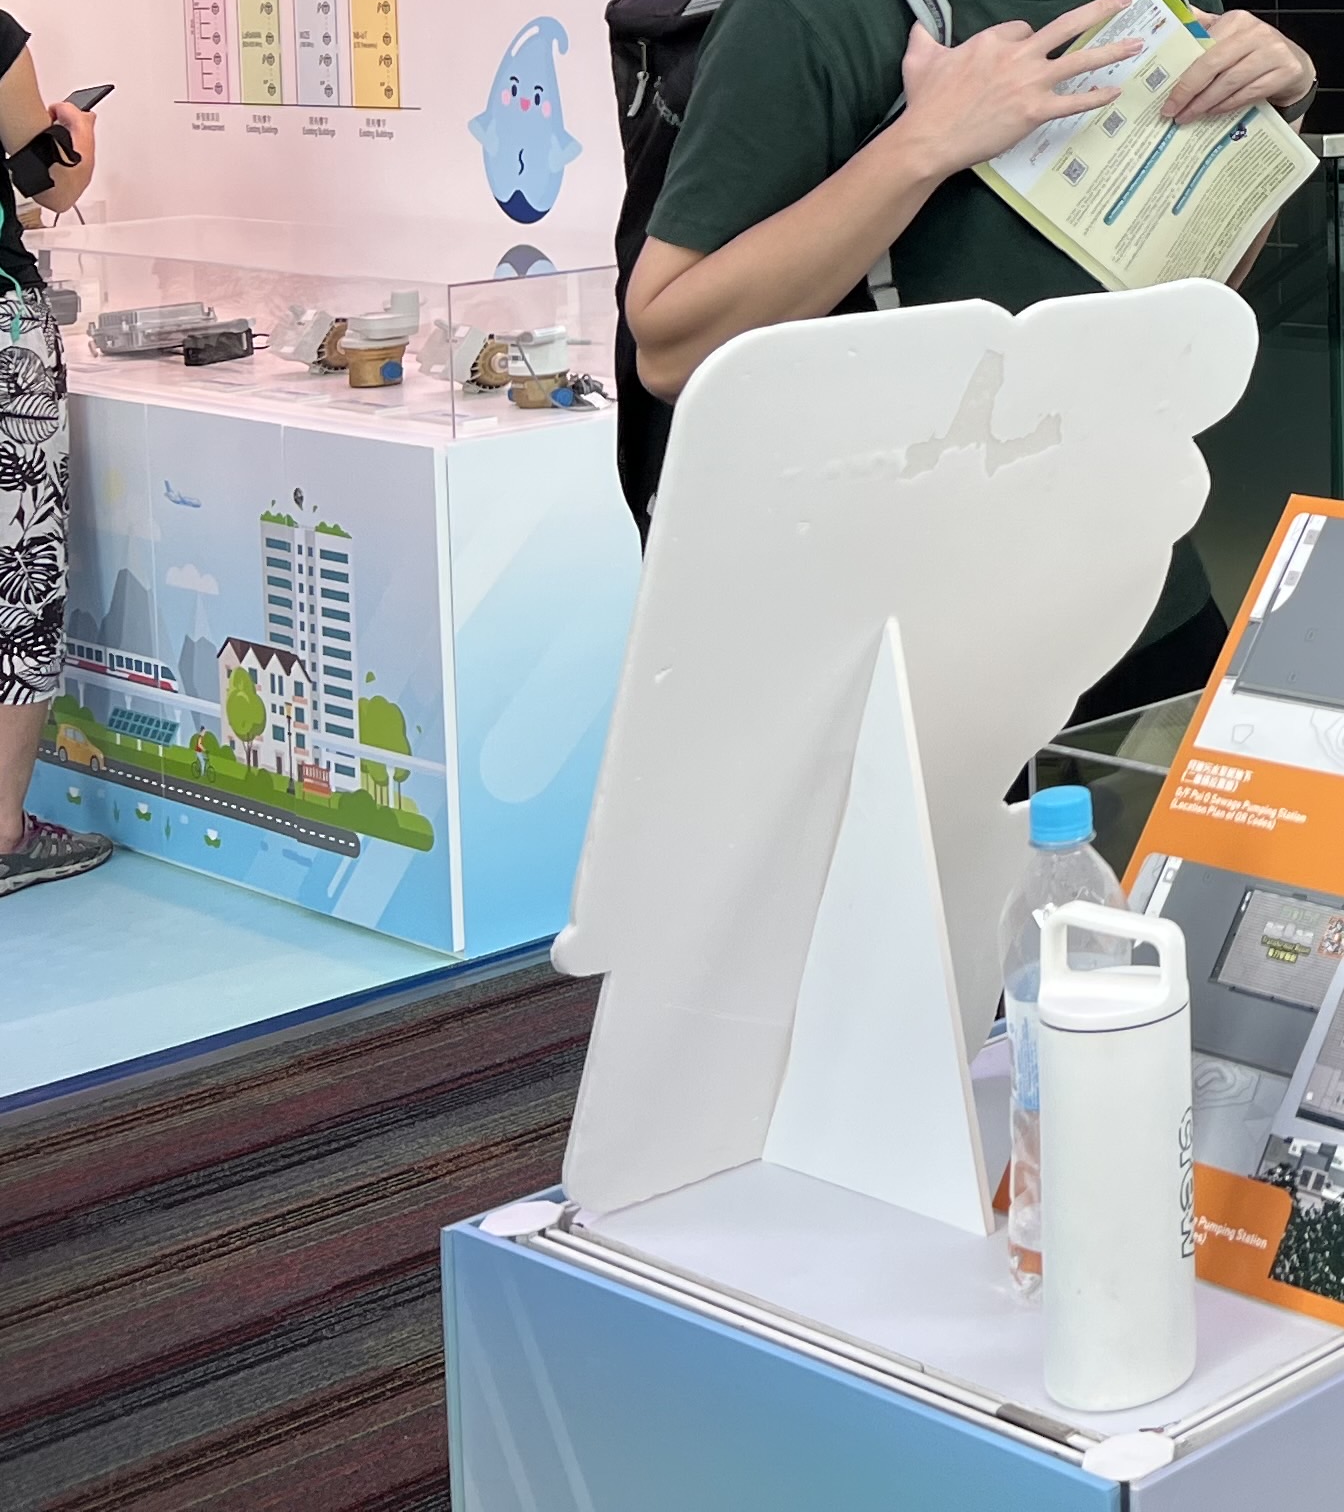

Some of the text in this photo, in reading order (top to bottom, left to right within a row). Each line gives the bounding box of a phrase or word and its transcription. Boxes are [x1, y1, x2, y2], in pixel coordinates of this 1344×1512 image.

[1169, 797, 1277, 831] (Location Plan of QR Codes)
[1211, 793, 1242, 811] Sewage
[1241, 799, 1278, 819] Pumping
[1278, 807, 1307, 824] Station
[1198, 1215, 1237, 1241] Pumping
[1236, 1228, 1268, 1249] Station
